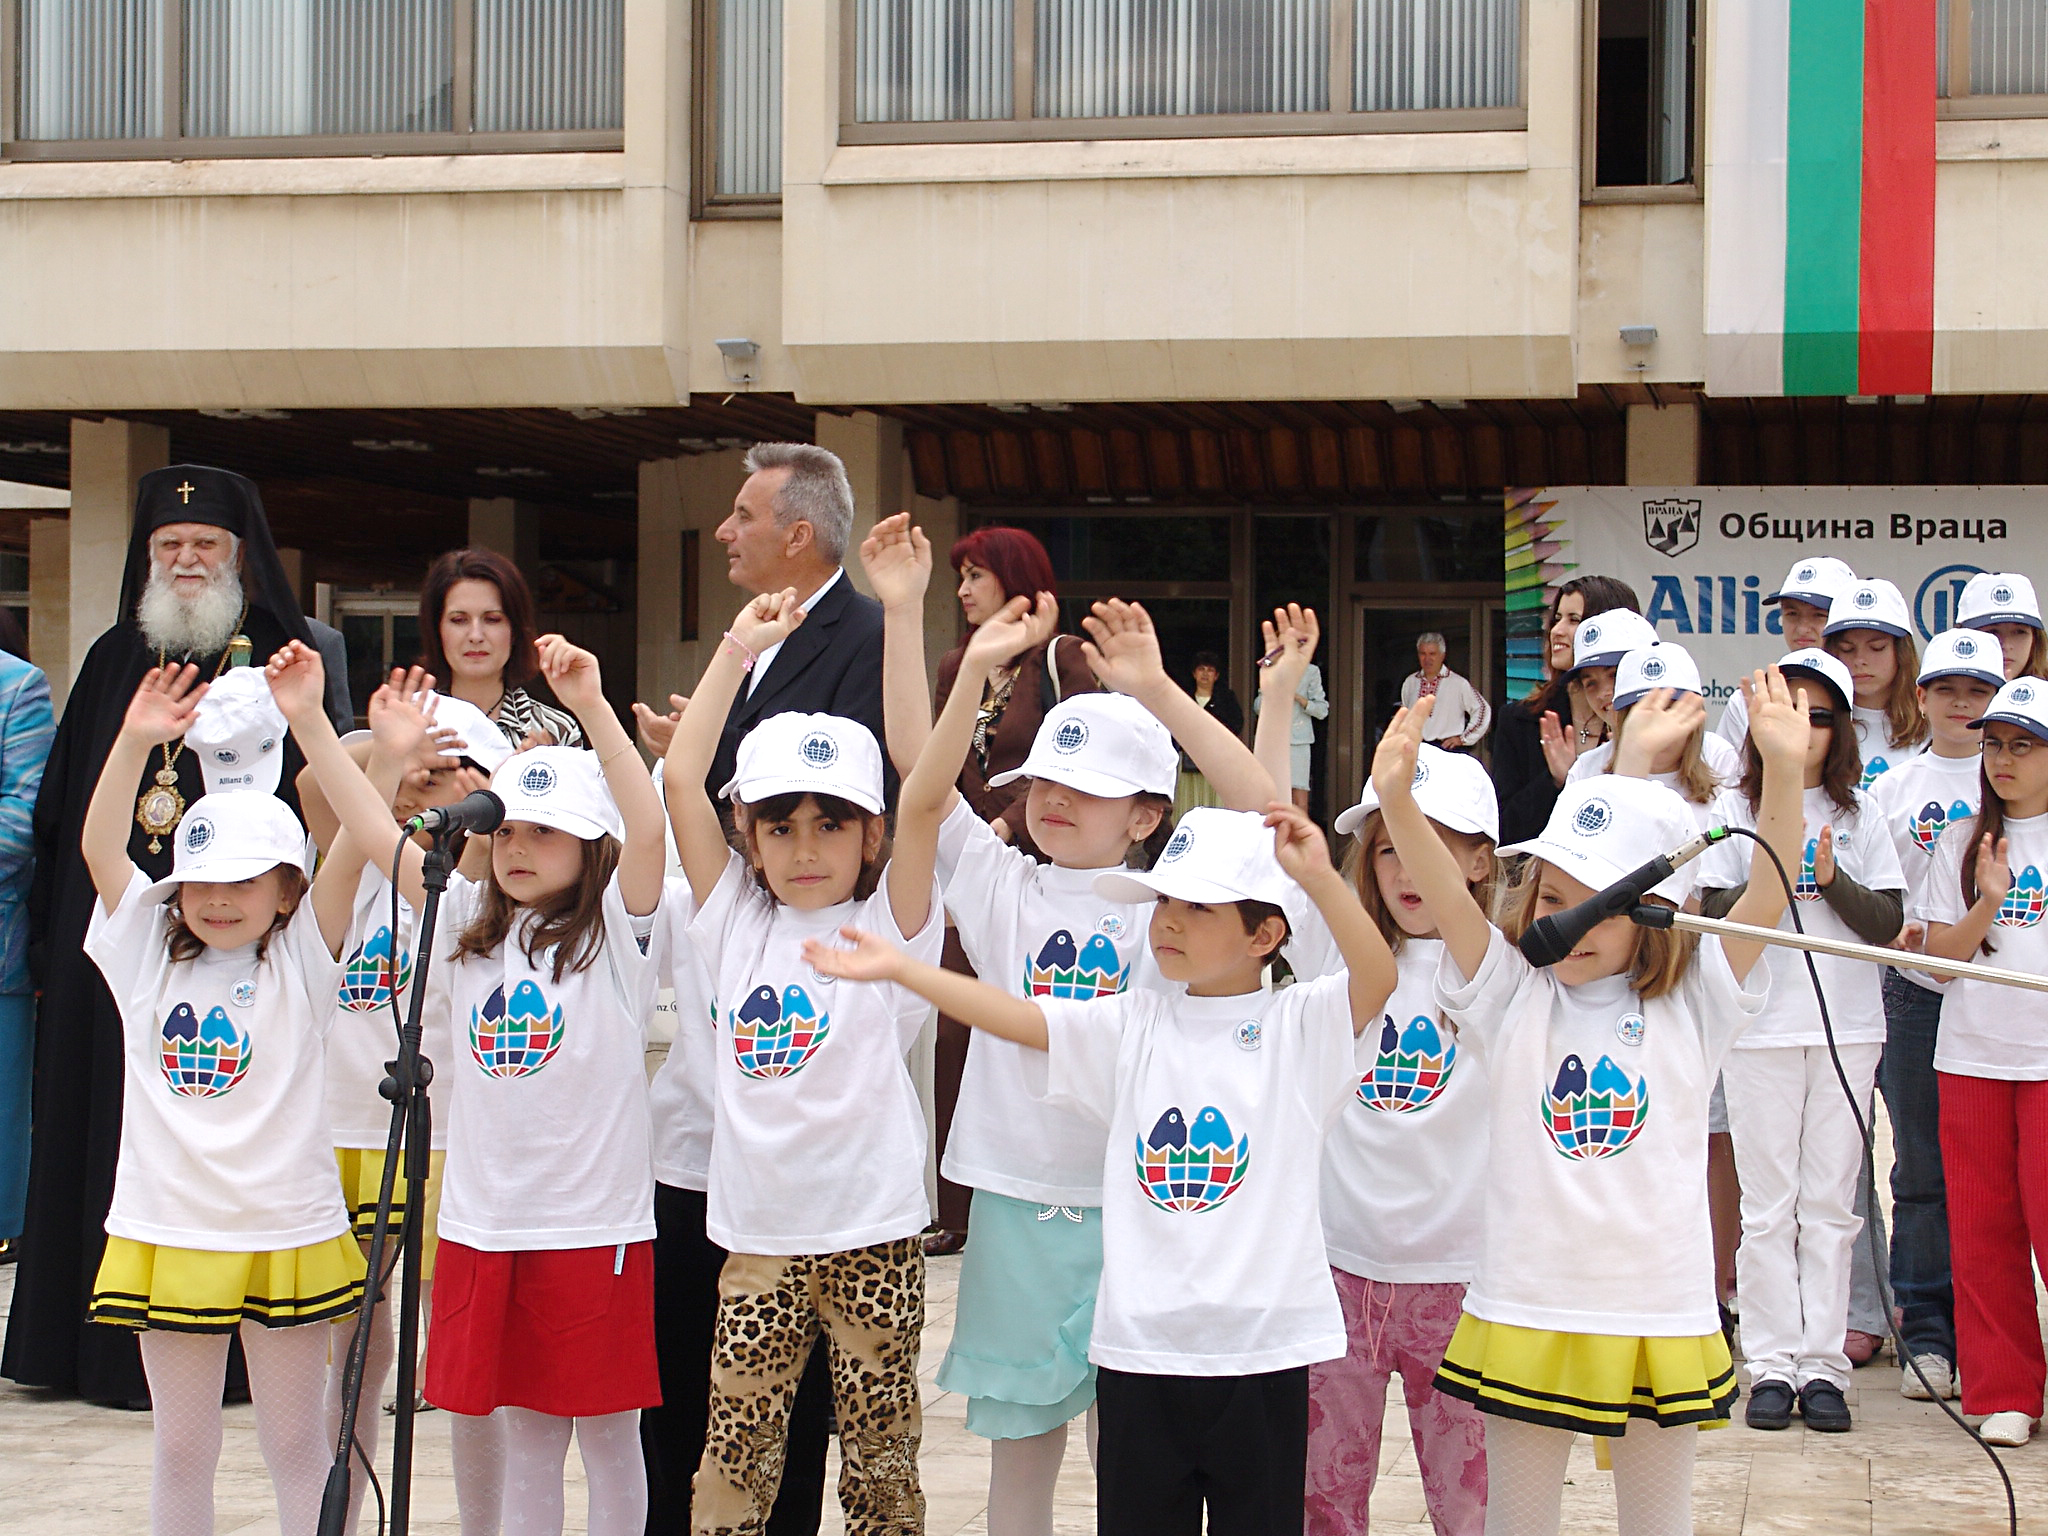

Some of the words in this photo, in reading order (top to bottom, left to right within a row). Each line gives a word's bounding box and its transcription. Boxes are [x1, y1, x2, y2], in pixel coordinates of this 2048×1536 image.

[1719, 512, 1874, 543] Община
[1890, 513, 2007, 545] Враца
[219, 777, 242, 785] Allianz
